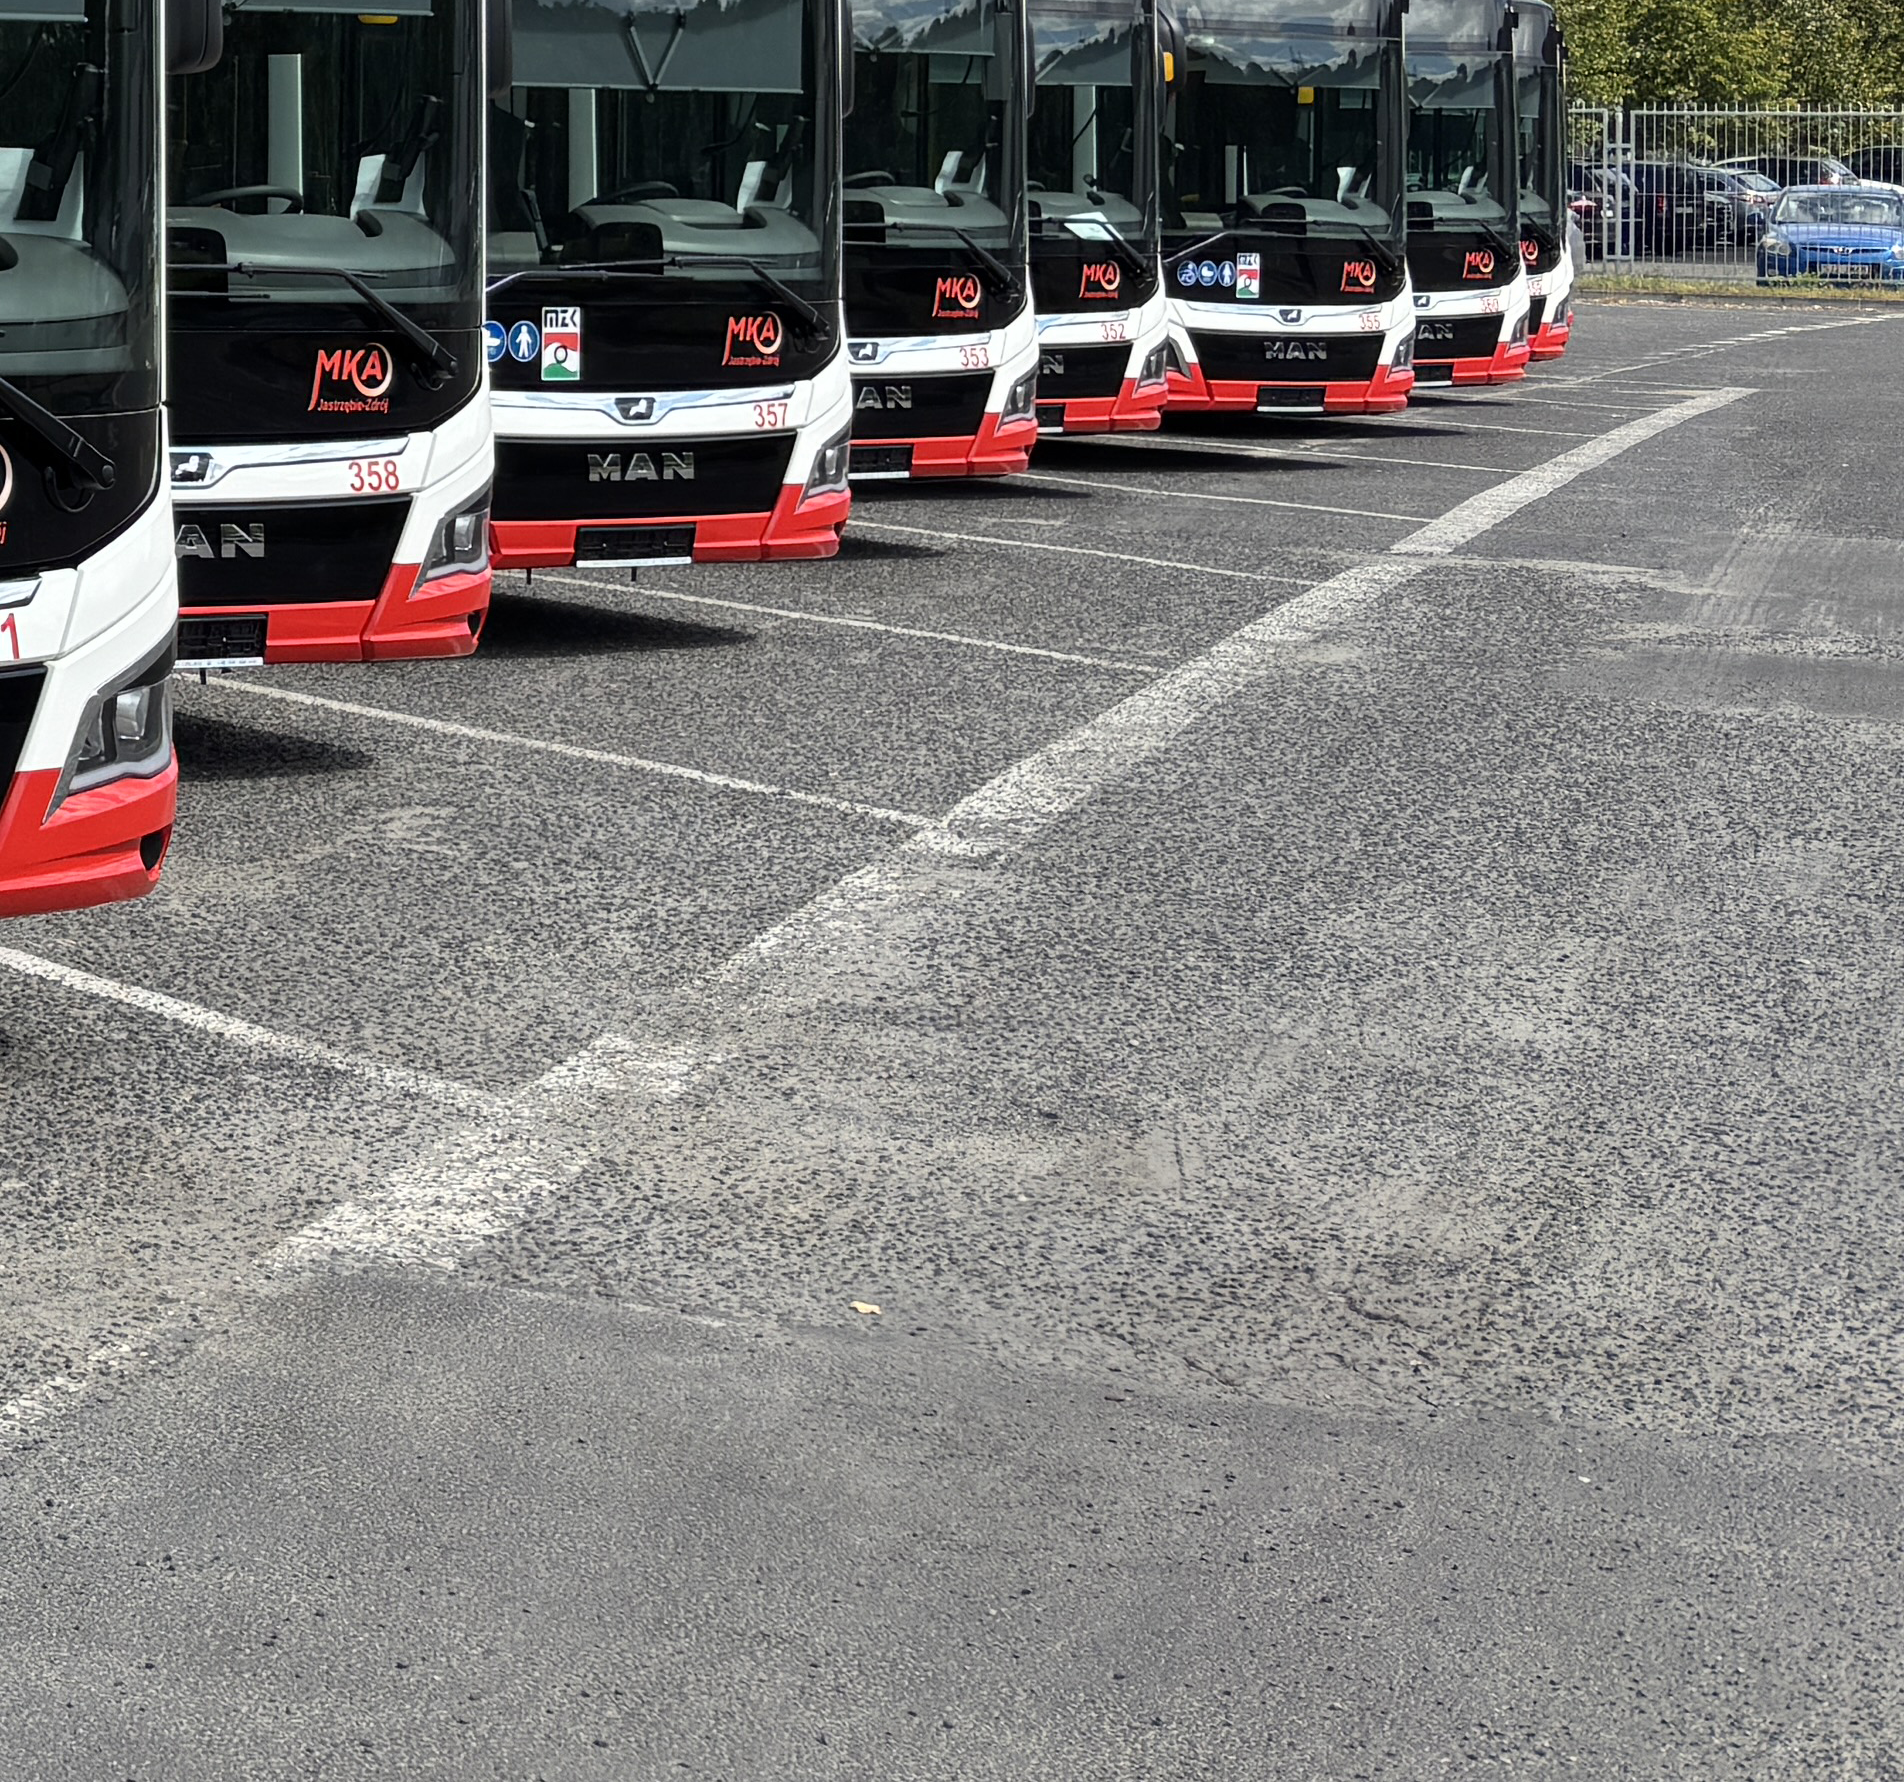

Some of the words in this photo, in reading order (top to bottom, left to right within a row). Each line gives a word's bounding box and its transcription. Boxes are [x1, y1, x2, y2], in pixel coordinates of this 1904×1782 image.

[1079, 259, 1120, 298] MKA
[1340, 258, 1376, 292] MKA
[932, 272, 981, 317] MKA
[545, 308, 577, 328] MZK
[1100, 323, 1126, 340] 352
[1358, 313, 1381, 330] 355
[1417, 323, 1453, 339] AN
[721, 310, 782, 366] MKA
[1264, 341, 1327, 360] MAN
[959, 347, 989, 367] 353
[307, 342, 393, 411] MKA
[856, 385, 912, 409] AN
[753, 402, 788, 428] 357
[348, 459, 400, 492] 358
[587, 451, 695, 481] MAN
[175, 523, 265, 559] AN
